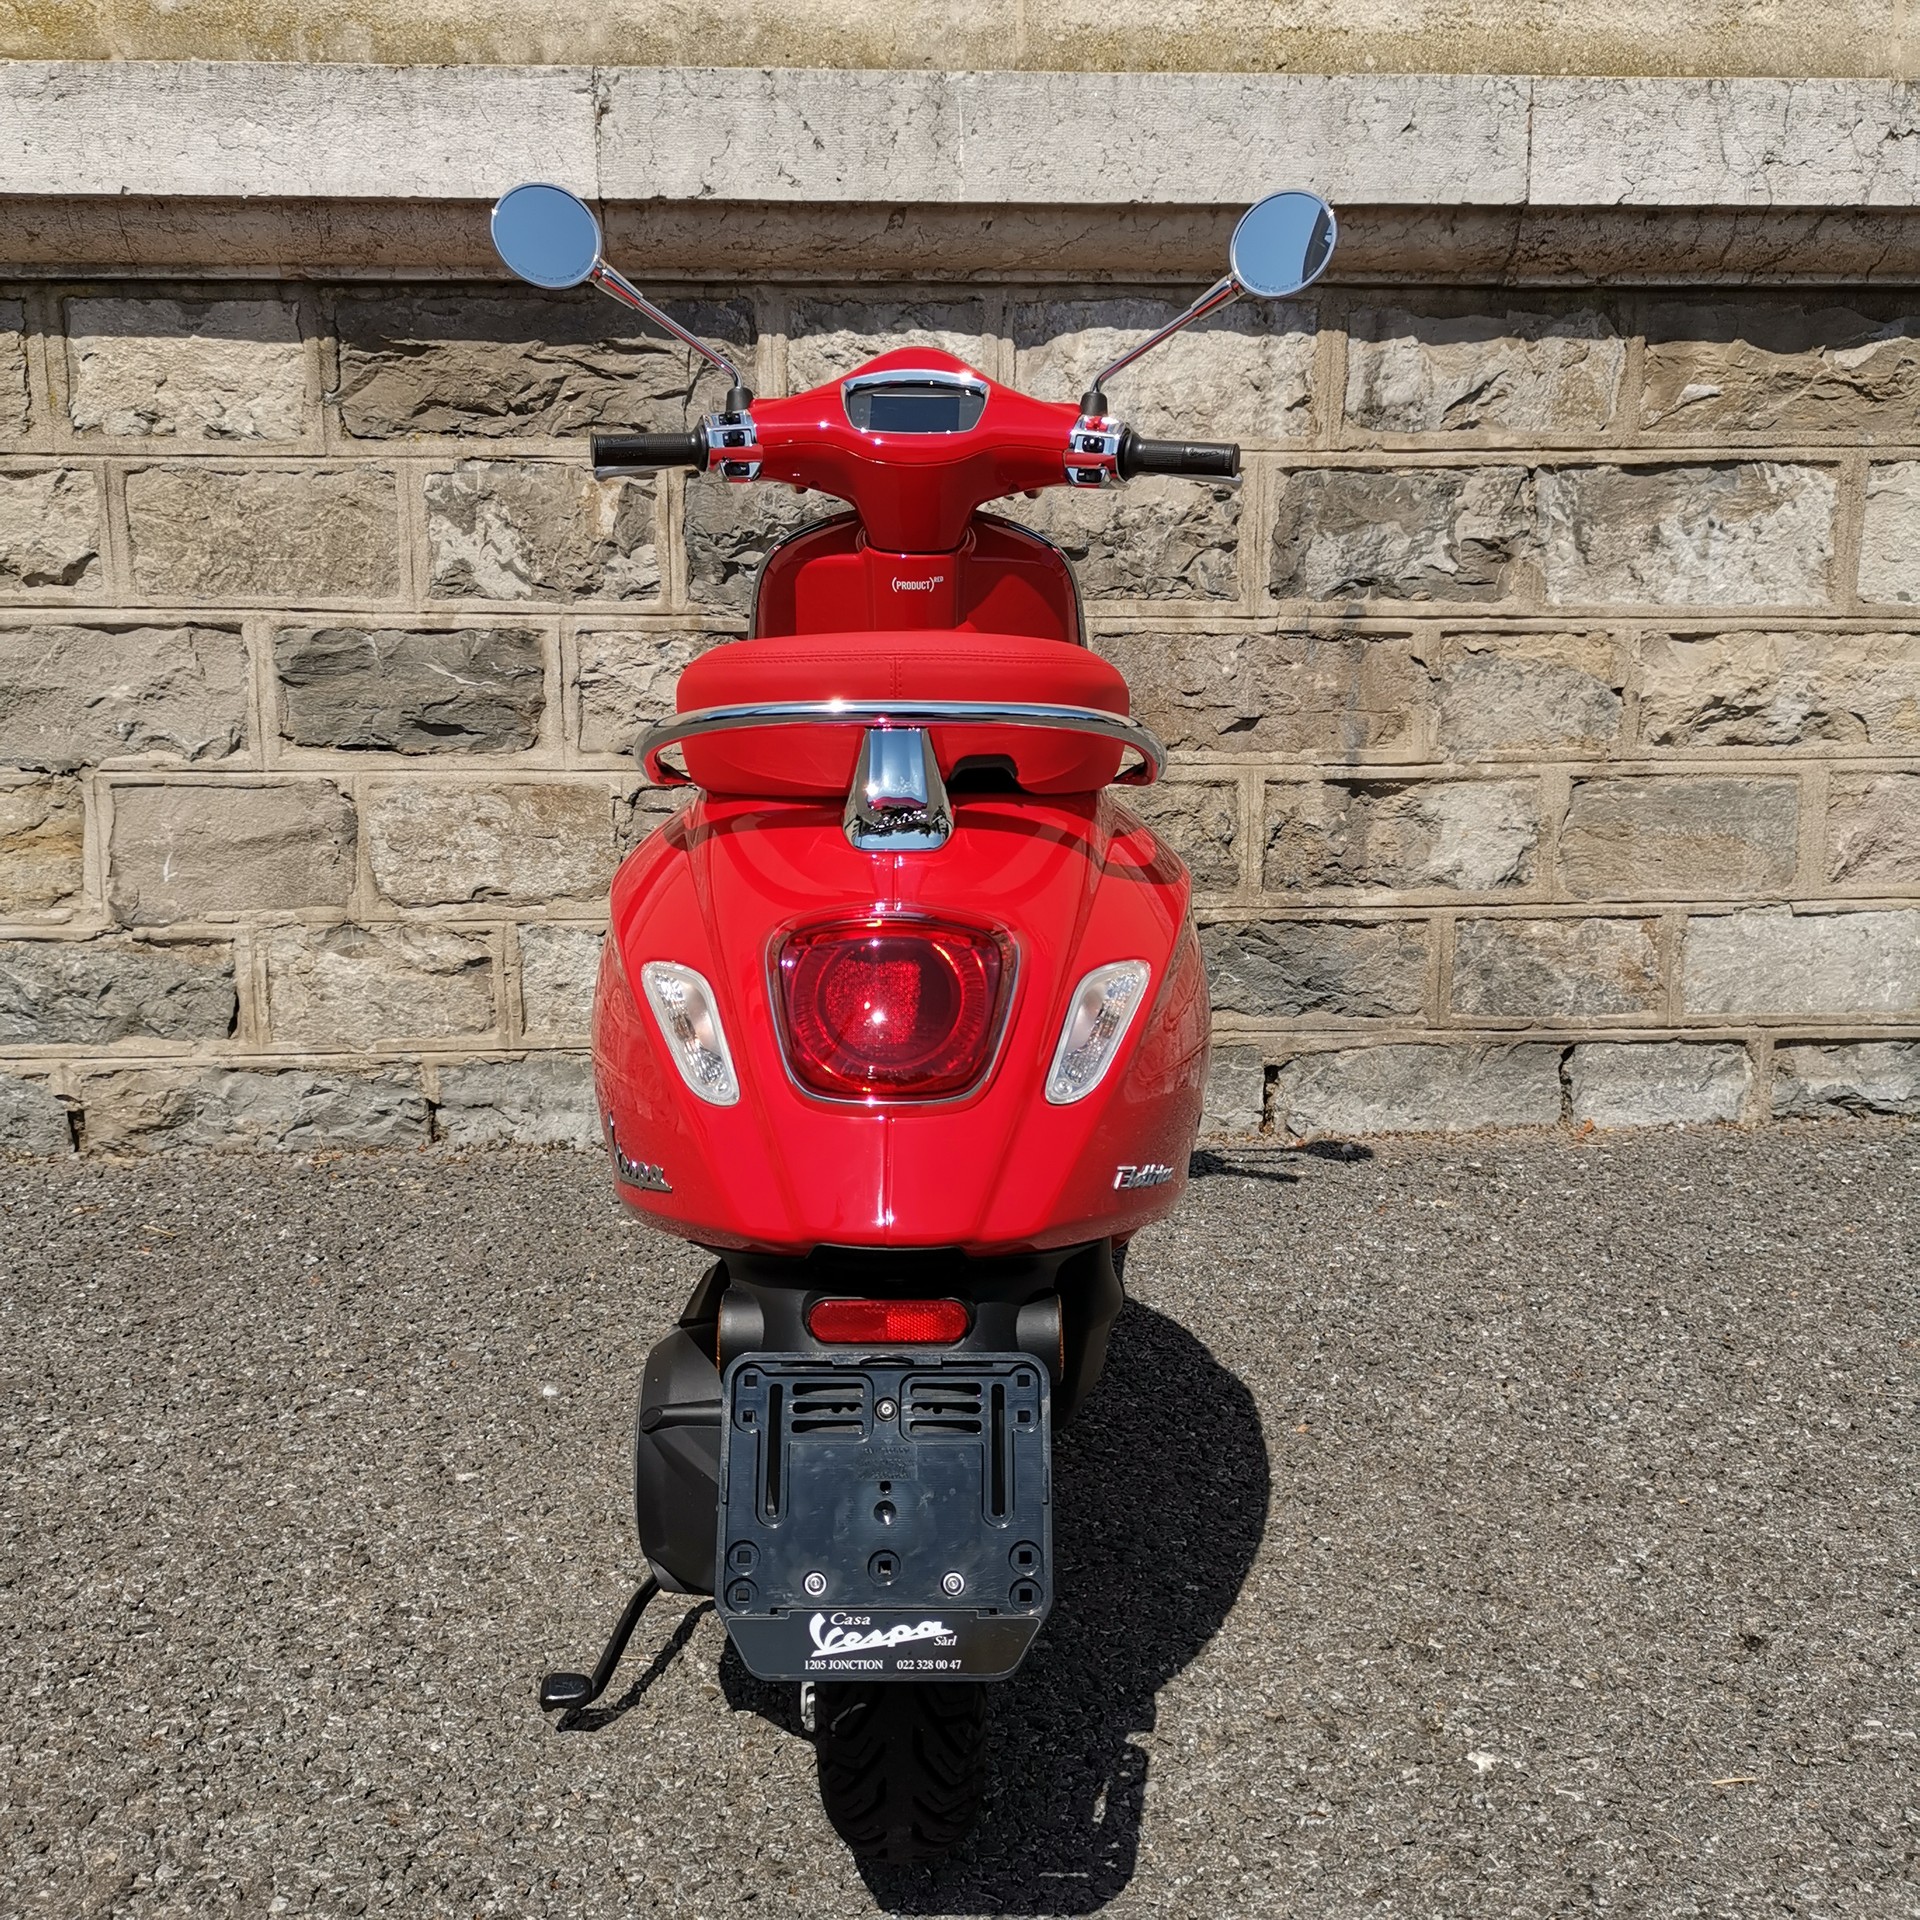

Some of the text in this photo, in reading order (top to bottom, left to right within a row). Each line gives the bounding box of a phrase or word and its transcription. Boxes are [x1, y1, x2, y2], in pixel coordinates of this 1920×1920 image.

[830, 1612, 871, 1626] Casa
[809, 1612, 954, 1657] Vespa
[804, 1660, 962, 1670] 1205 JONCTION 022 328 00 47
